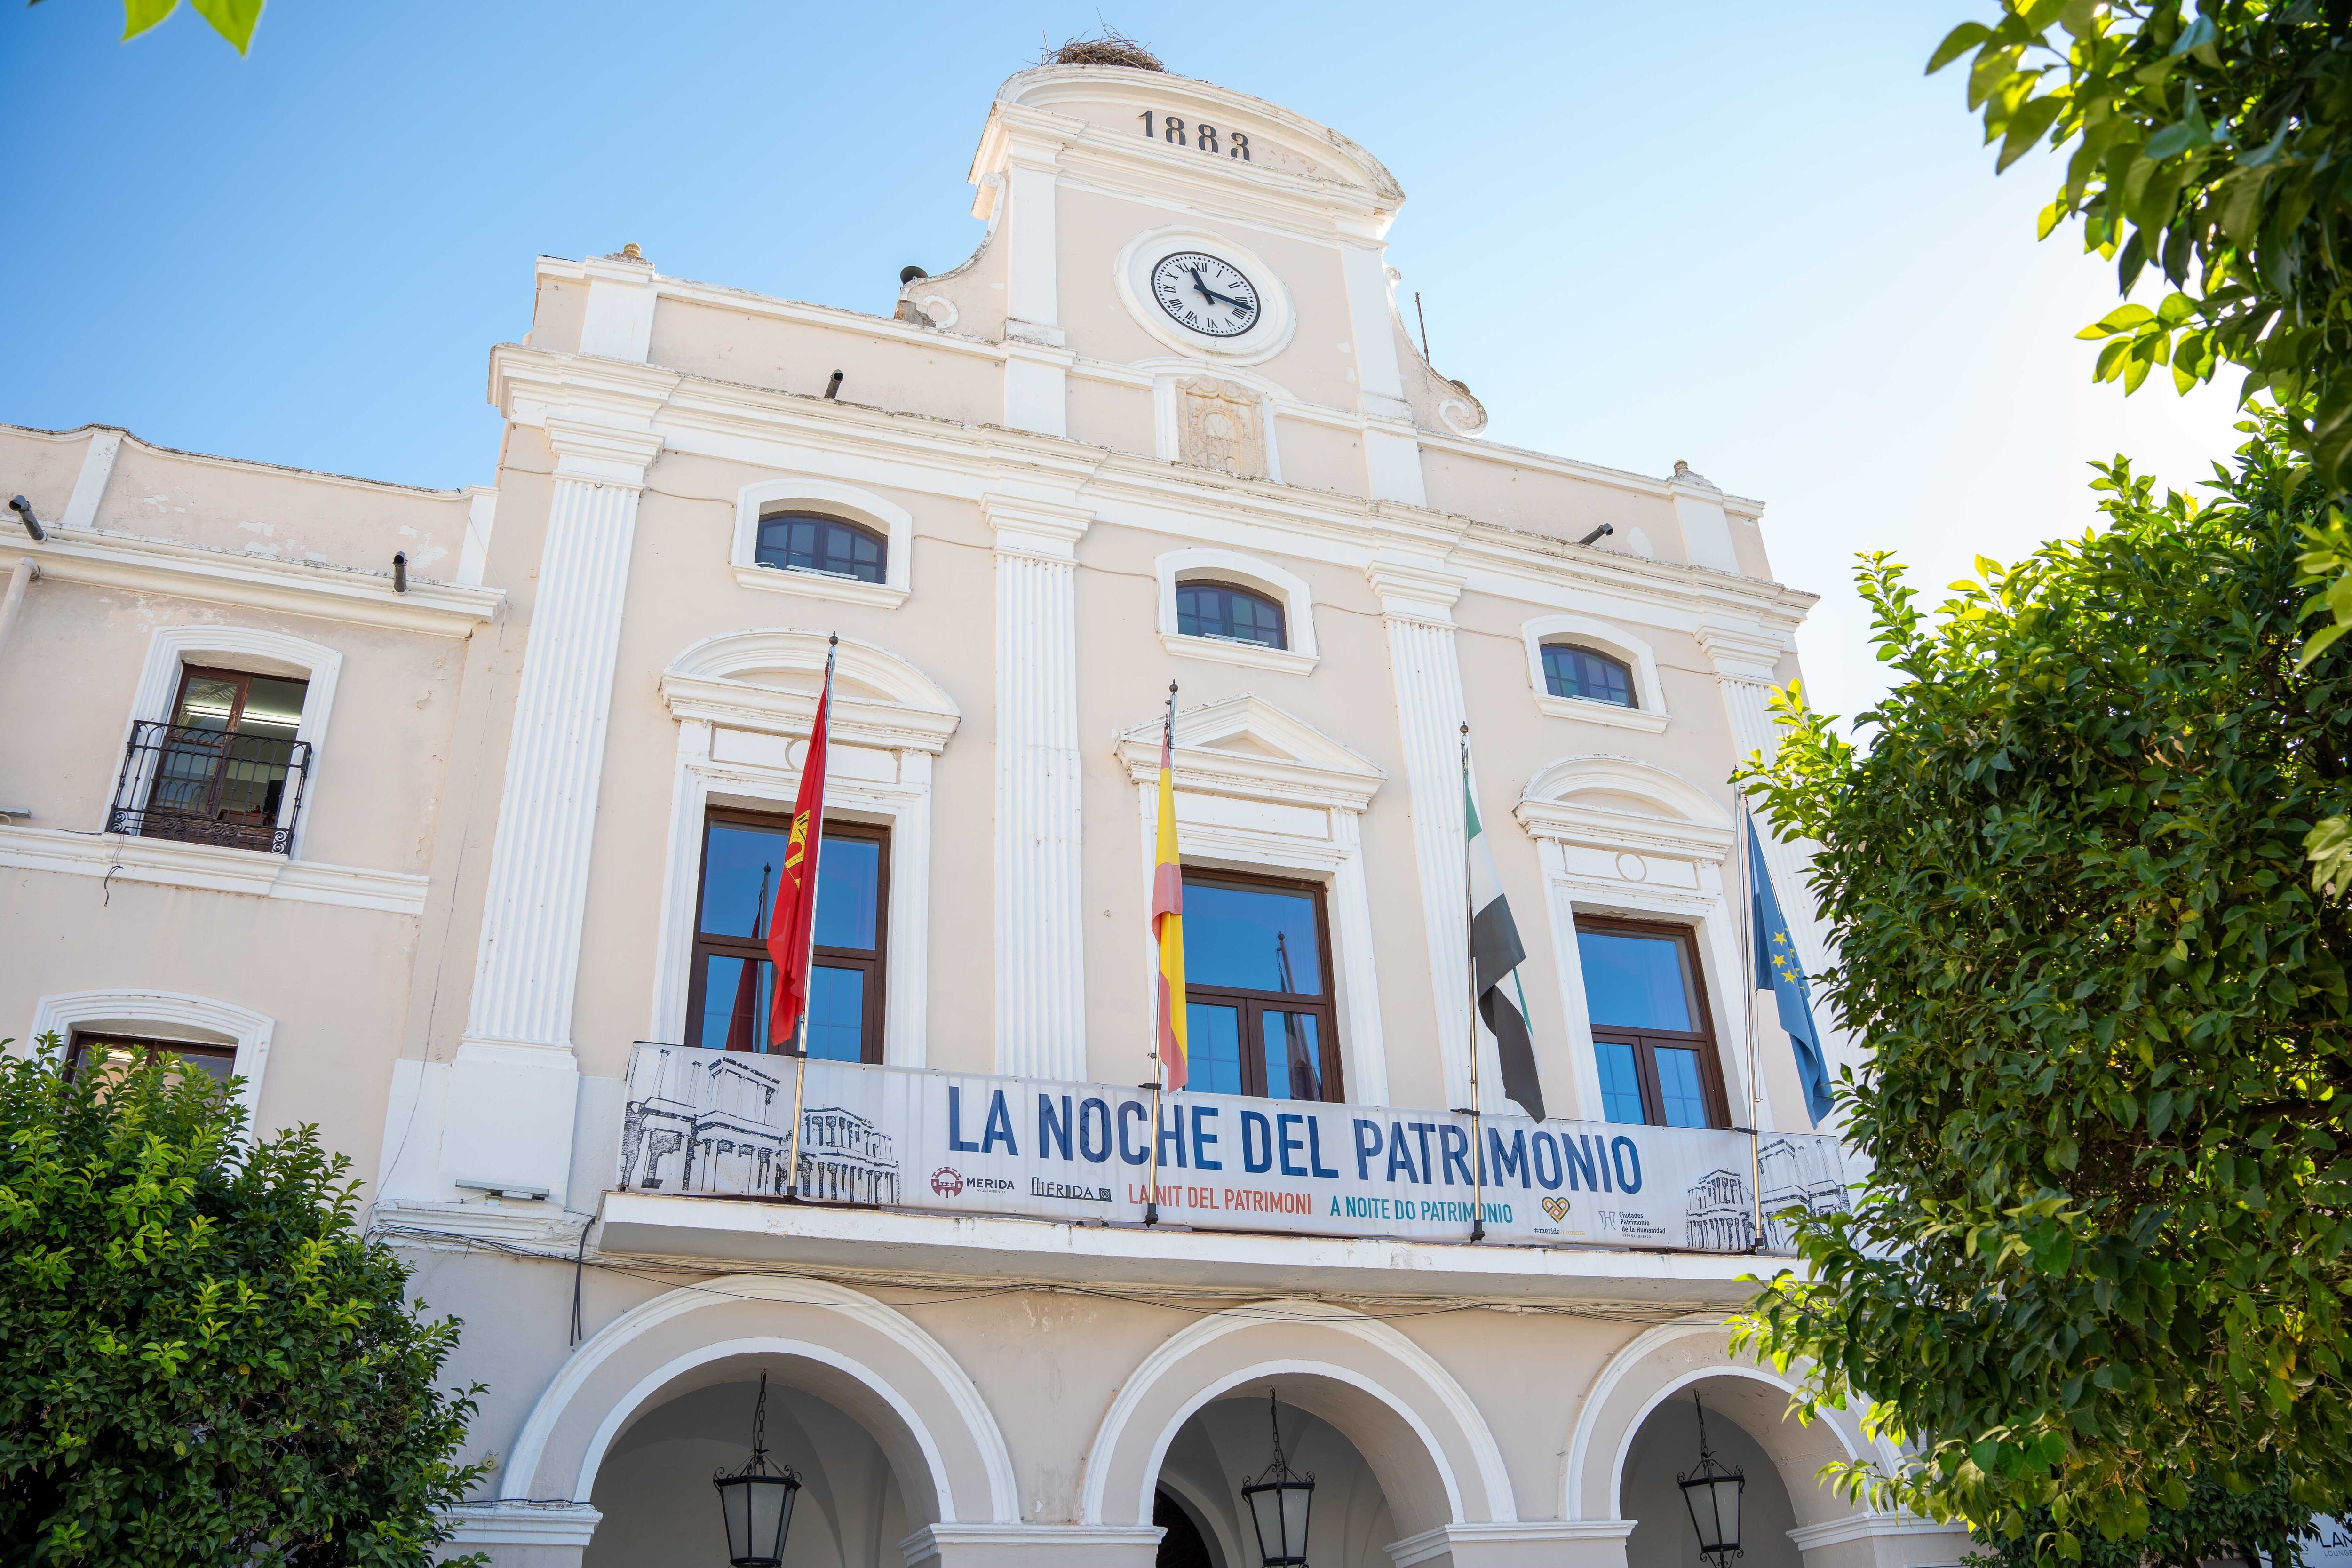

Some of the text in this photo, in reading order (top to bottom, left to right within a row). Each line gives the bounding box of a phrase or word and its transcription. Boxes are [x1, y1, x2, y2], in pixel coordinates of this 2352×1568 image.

[1137, 110, 1250, 161] 1883
[949, 1086, 1642, 1194] LA NOCHE DEL PATRIMONIO
[967, 1178, 1015, 1190] MÉRIDA
[1129, 1184, 1311, 1215] LA NIT DEL PATRIMONI
[1330, 1195, 1513, 1223] A NOITE DO PATRIMONIO
[1534, 1227, 1586, 1236] #meridaenamora
